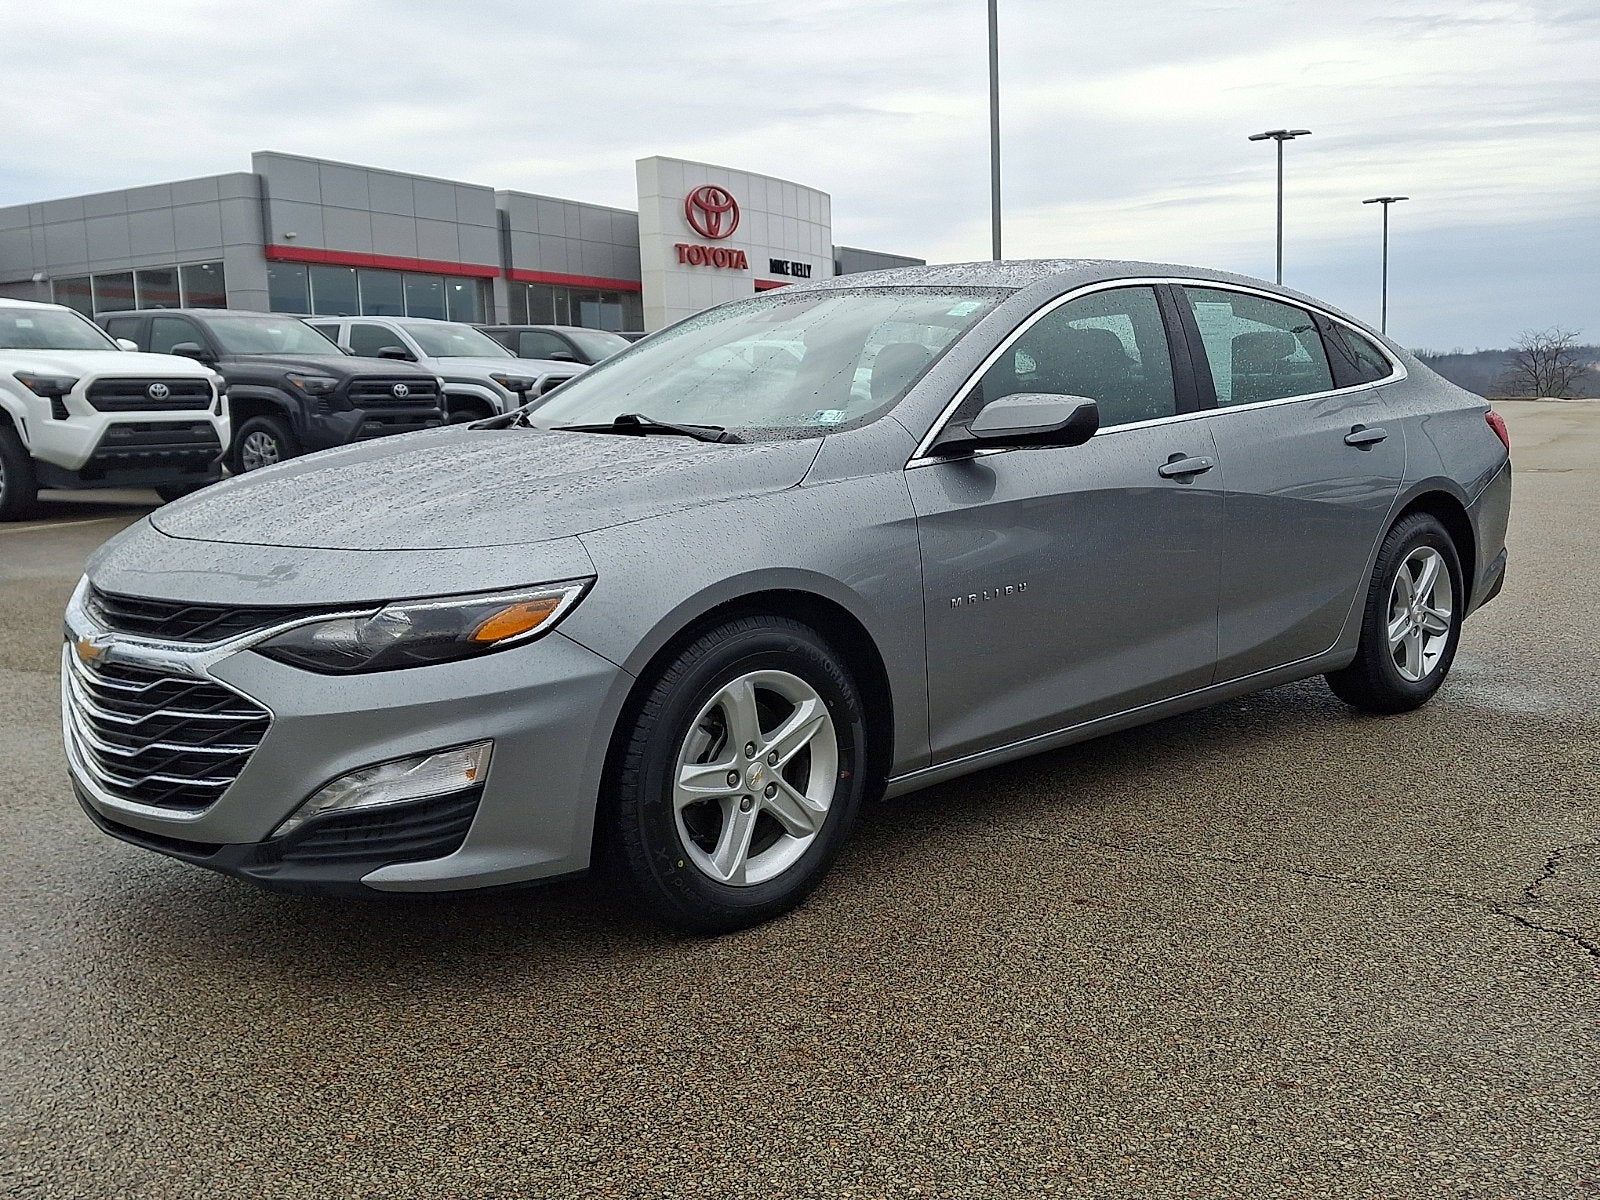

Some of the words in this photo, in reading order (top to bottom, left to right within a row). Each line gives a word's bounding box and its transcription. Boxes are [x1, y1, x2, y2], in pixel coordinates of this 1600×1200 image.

[674, 243, 749, 269] TOYOTA
[769, 257, 790, 275] MIKE
[791, 261, 812, 278] KELLY
[950, 582, 1028, 610] MALIBU
